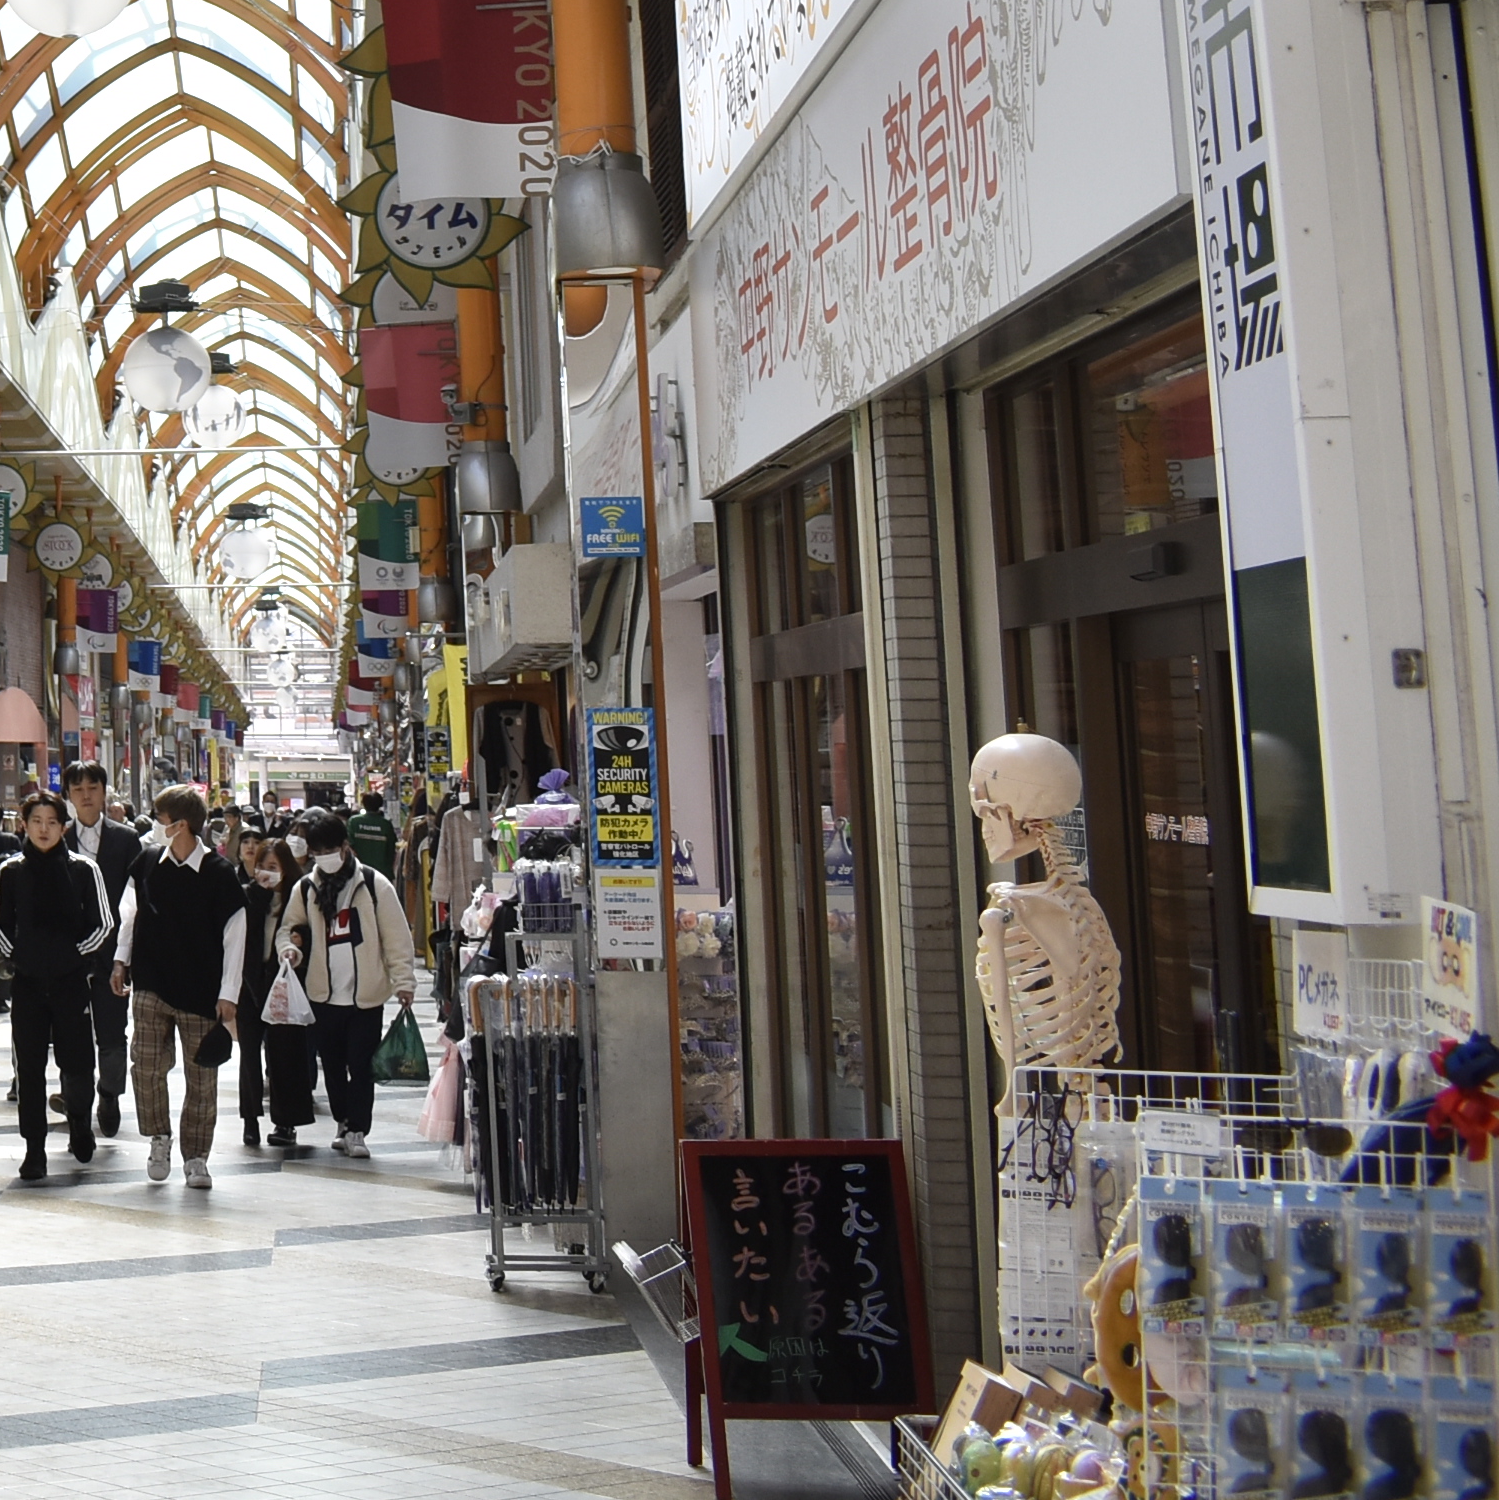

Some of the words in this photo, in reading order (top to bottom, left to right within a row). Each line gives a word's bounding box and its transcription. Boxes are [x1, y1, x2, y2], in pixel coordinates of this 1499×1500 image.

[516, 97, 555, 198] 2020
[738, 1, 999, 394] 中野サンモール整骨院
[387, 202, 478, 230] タイム
[395, 236, 467, 258] サンモール
[1203, 211, 1231, 380] ICHIBA
[42, 539, 74, 551] STOCK
[586, 533, 613, 544] FREE
[43, 557, 74, 568] サンモール
[593, 711, 648, 724] WARNING!
[612, 756, 632, 768] 24H
[597, 769, 647, 781] SECURITY
[598, 782, 649, 794] CAMERAS
[600, 818, 649, 828] 防犯カメラ
[608, 829, 644, 840] 作動中!
[1298, 964, 1340, 1007] PCメガネ
[1220, 1213, 1264, 1223] CONTROL
[731, 1168, 779, 1324] 言いたい
[782, 1161, 831, 1330] あるある
[838, 1163, 899, 1390] こむら返り
[767, 1337, 830, 1359] 原因は
[770, 1368, 824, 1388] コチラ
